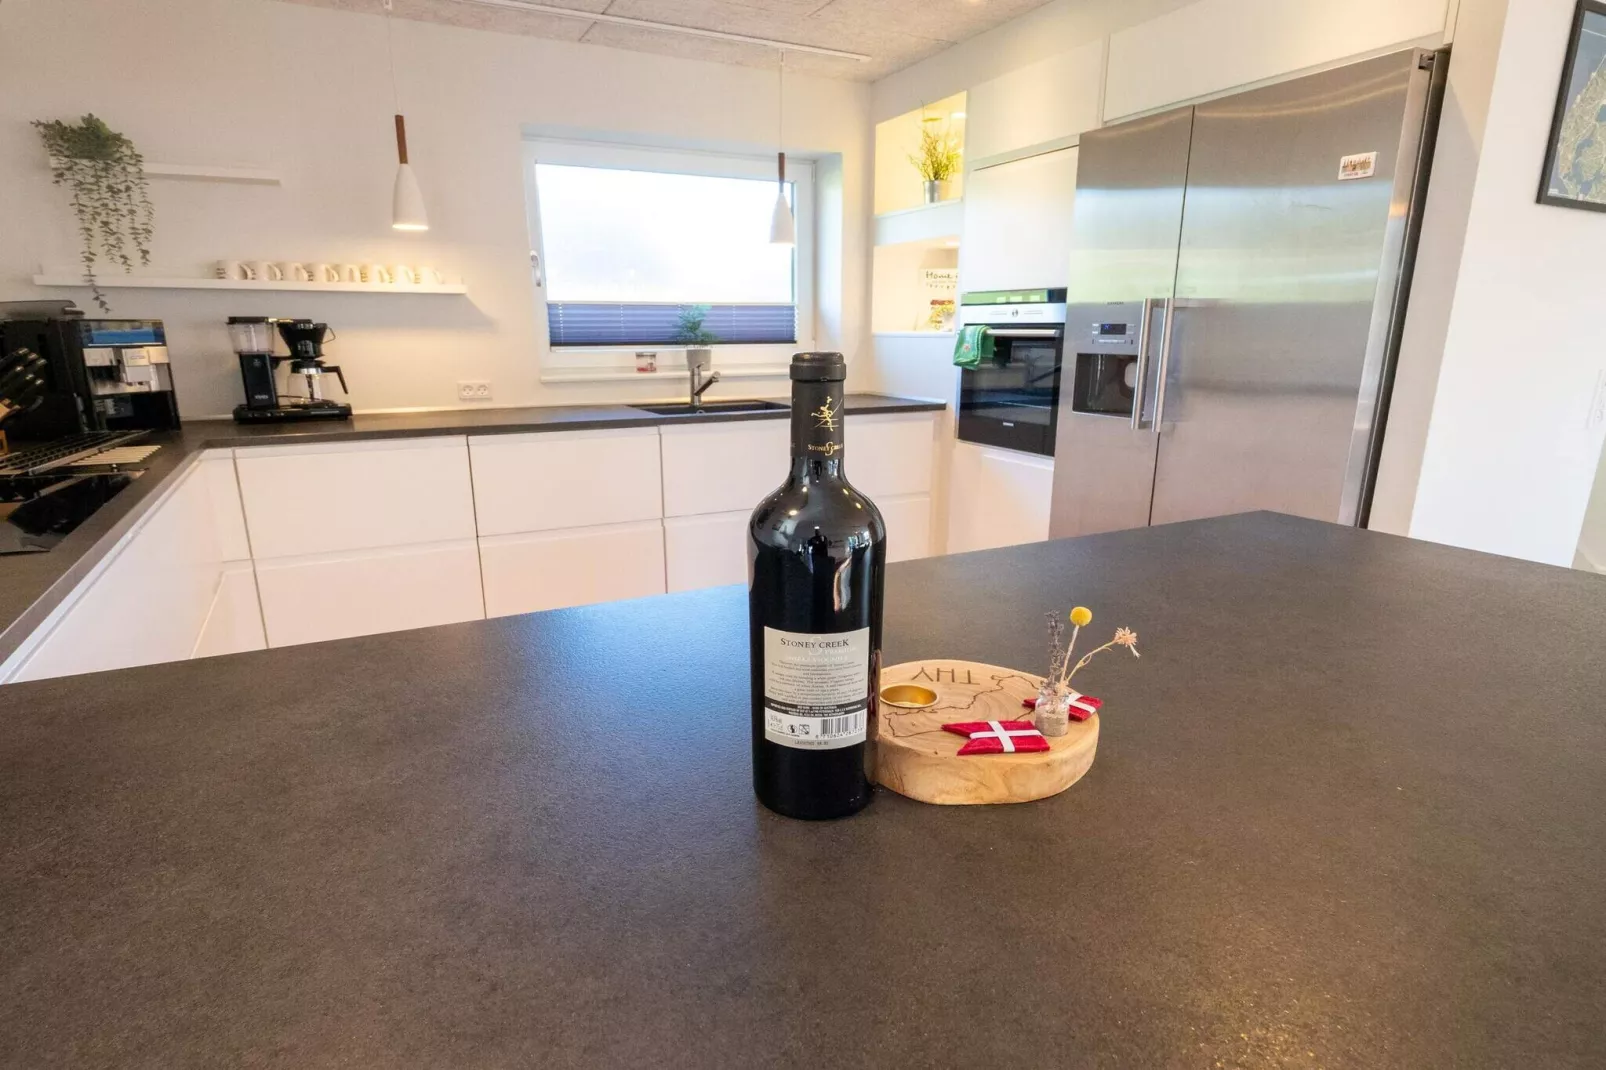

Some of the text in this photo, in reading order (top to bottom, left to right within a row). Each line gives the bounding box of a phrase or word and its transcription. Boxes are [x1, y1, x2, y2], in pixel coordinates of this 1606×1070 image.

[780, 637, 849, 649] STONEY CREEK
[911, 666, 980, 685] THY
